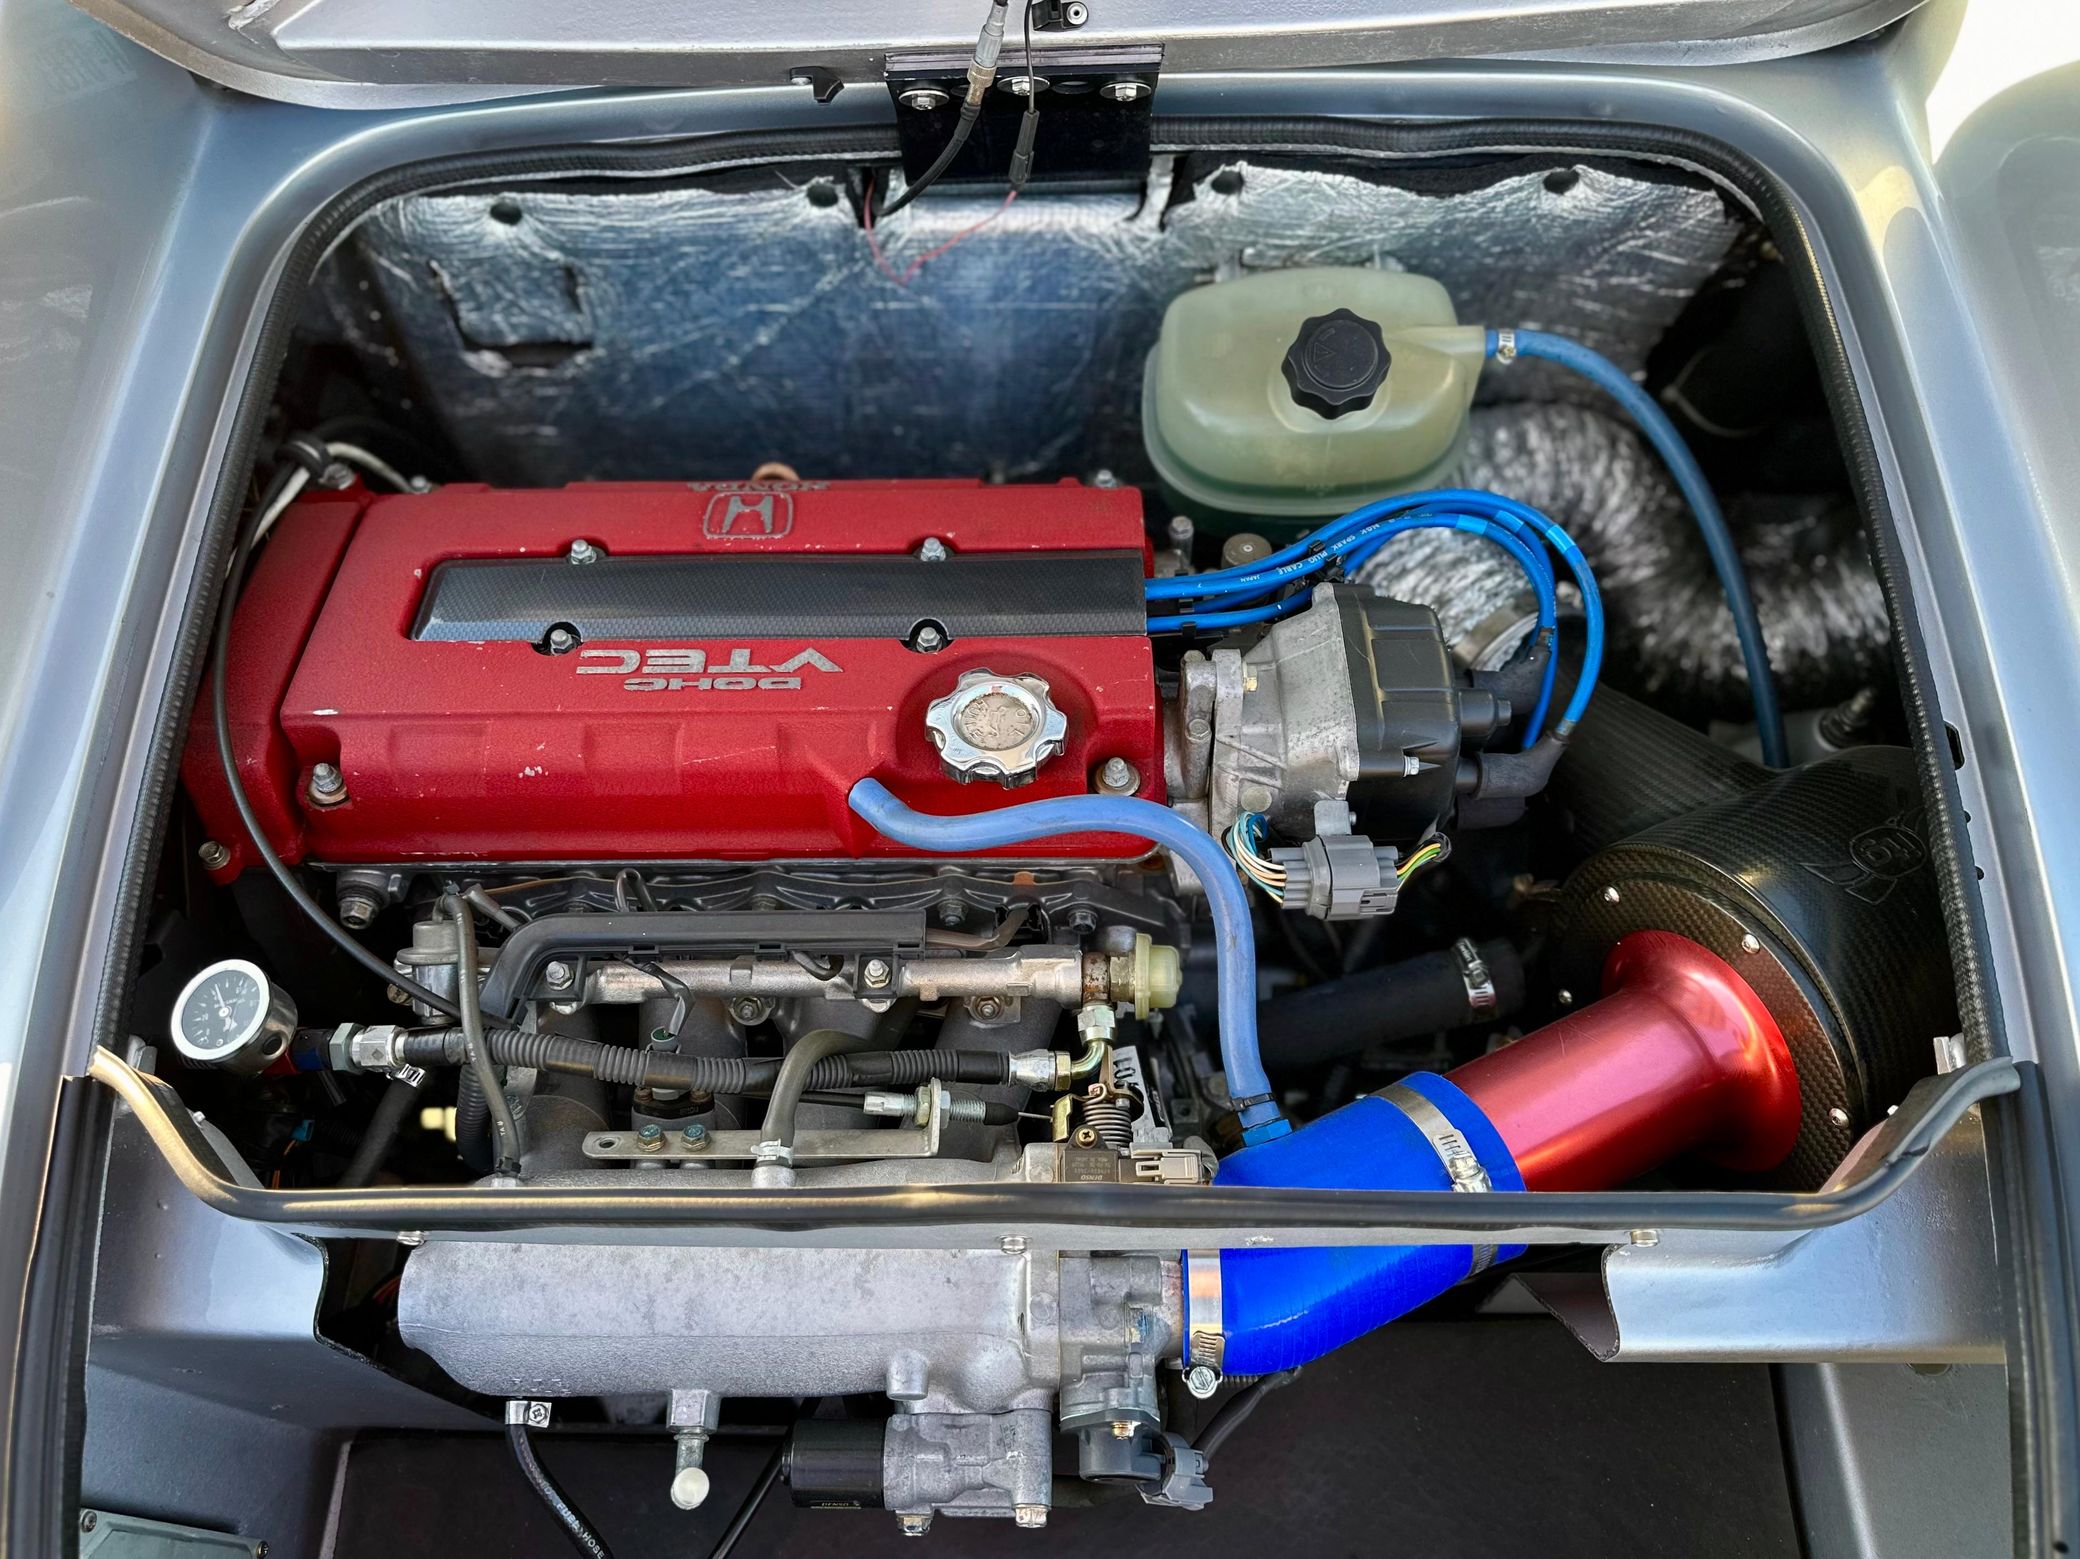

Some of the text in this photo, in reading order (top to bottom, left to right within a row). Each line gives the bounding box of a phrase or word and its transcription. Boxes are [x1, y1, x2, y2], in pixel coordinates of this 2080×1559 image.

[1239, 522, 1380, 583] NGK SPARK PLUG CABLE JAPAN
[576, 646, 844, 675] VTEC
[623, 676, 802, 691] DOHC
[582, 1531, 606, 1559] HOSE
